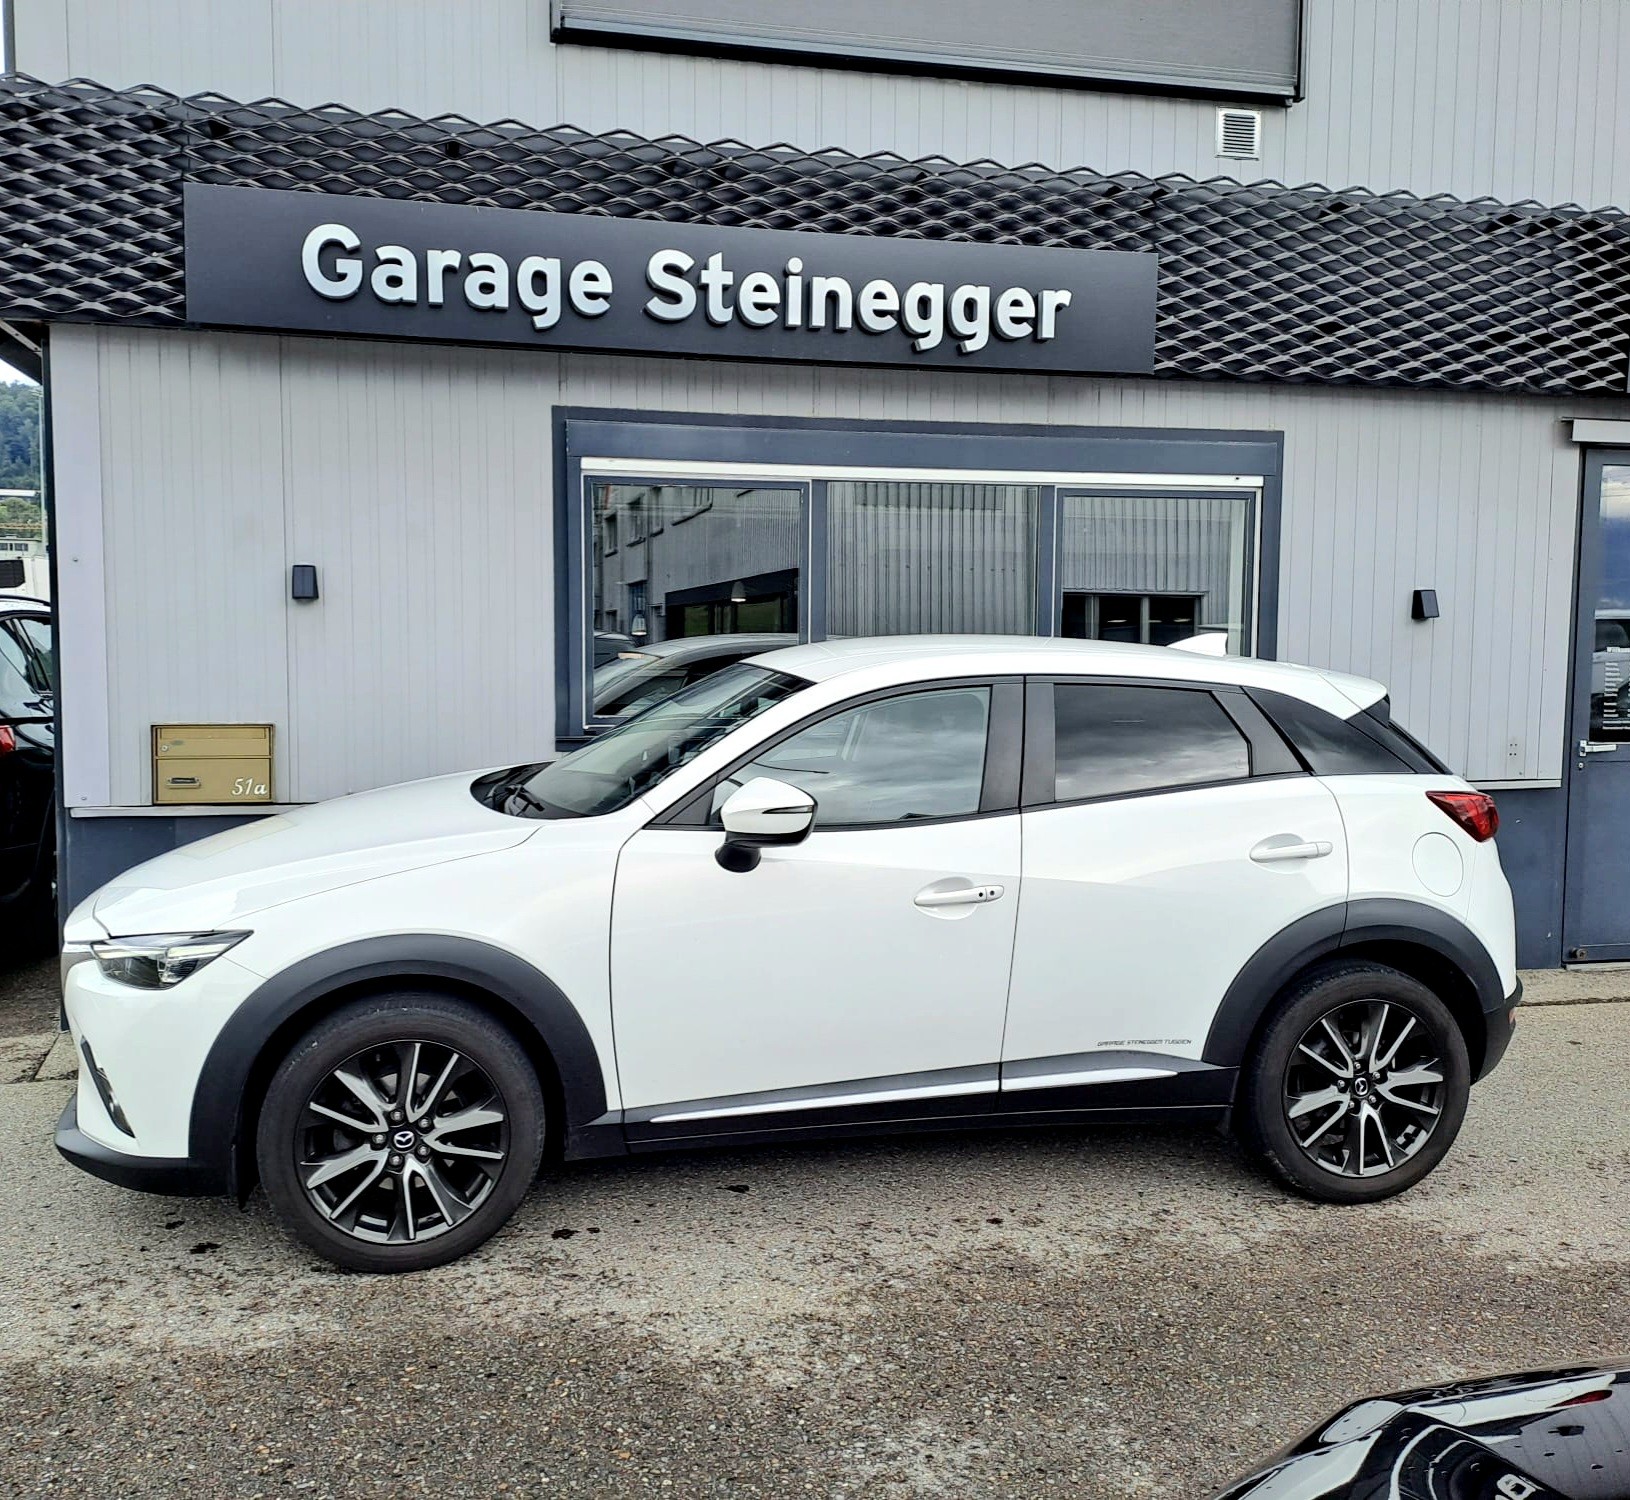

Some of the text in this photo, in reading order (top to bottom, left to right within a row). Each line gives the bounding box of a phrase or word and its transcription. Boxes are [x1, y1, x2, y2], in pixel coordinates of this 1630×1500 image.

[301, 223, 1072, 353] Garage Steinegger
[231, 778, 268, 795] 51a
